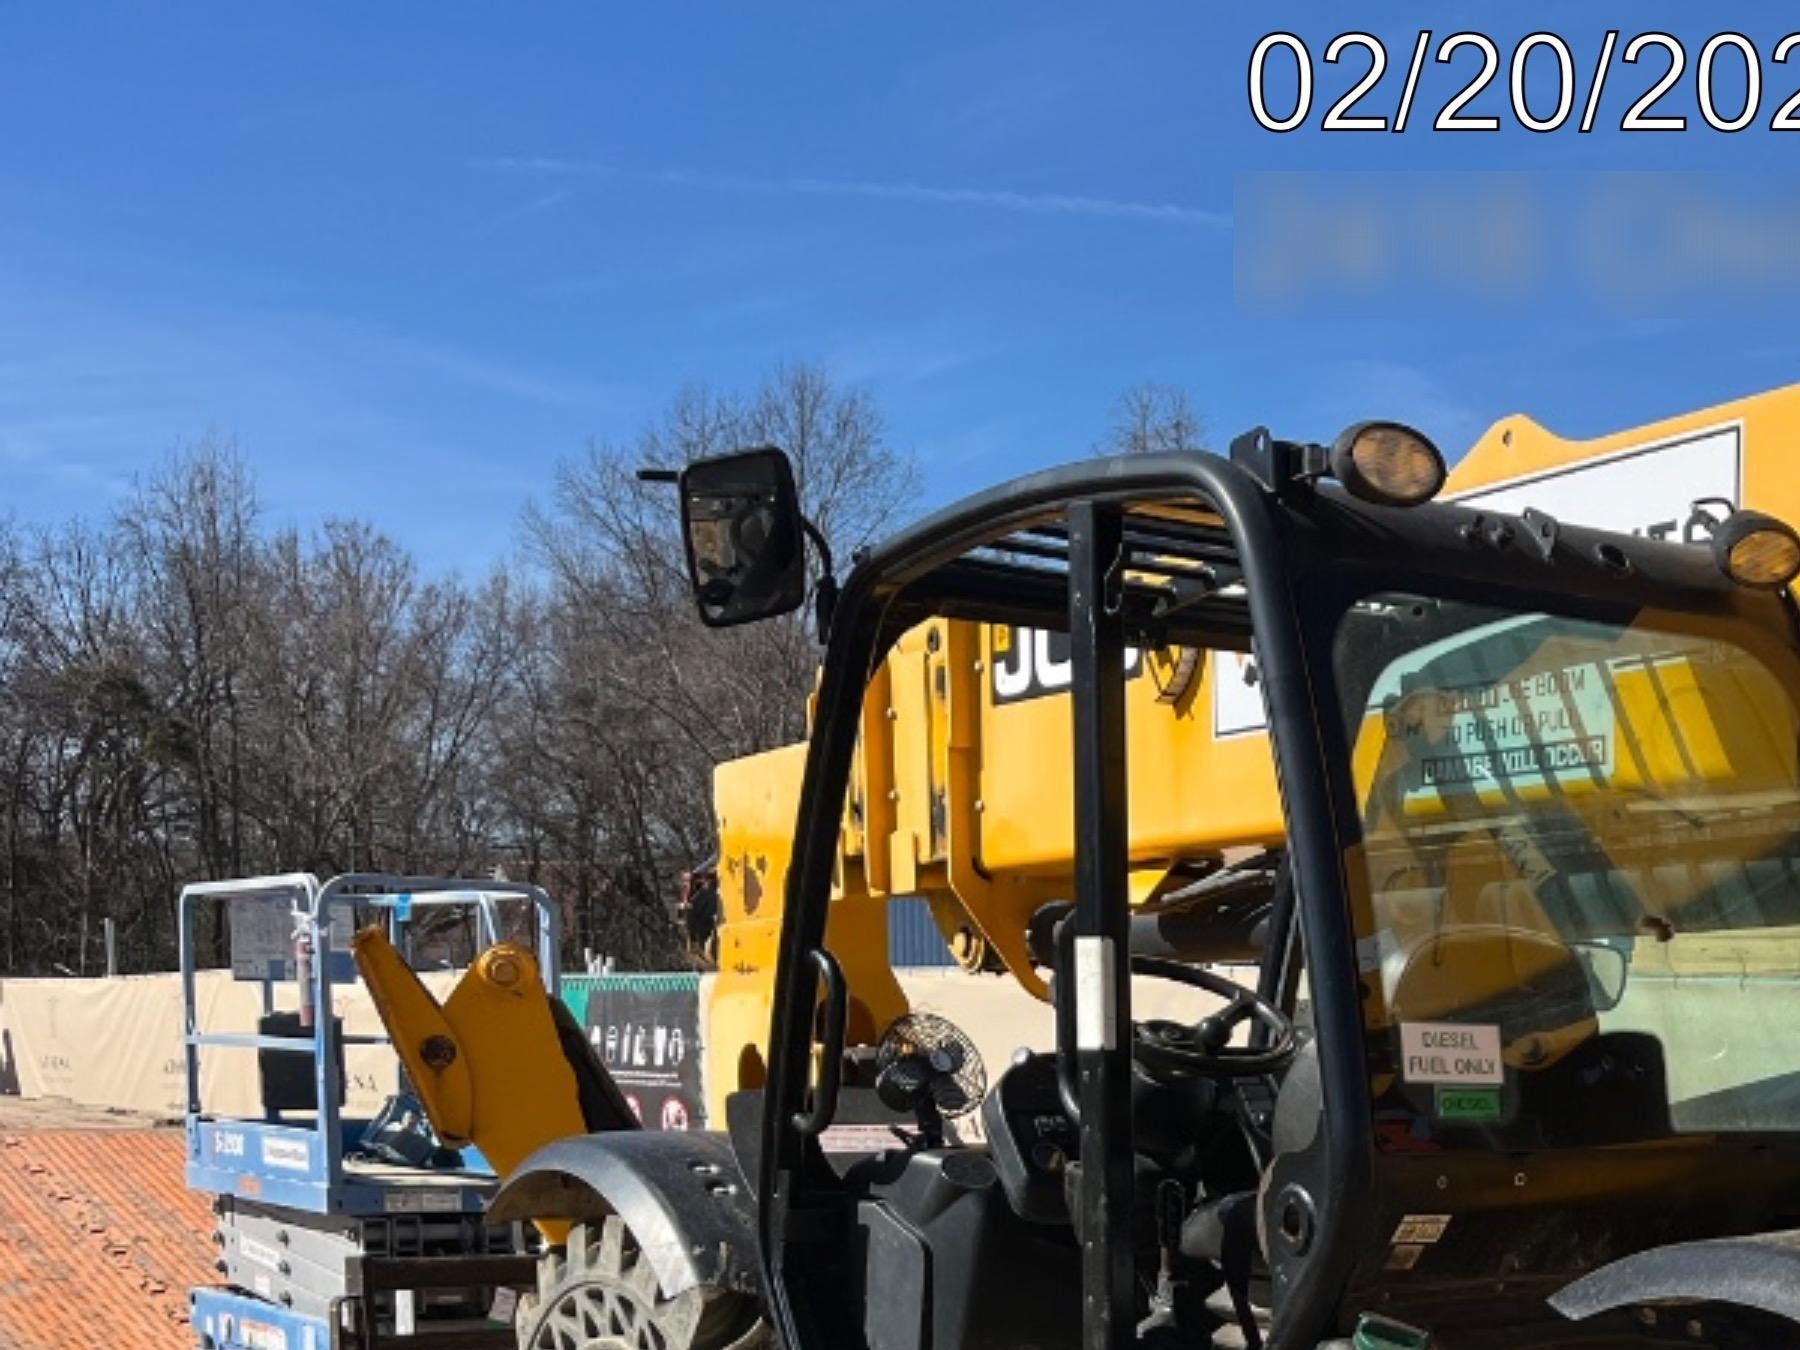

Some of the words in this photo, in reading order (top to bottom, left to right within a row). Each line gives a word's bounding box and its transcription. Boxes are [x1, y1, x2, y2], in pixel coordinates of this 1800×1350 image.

[1421, 1031, 1480, 1050] DIESEL
[1408, 1055, 1451, 1075] FUEL
[1454, 1058, 1495, 1075] ONLY
